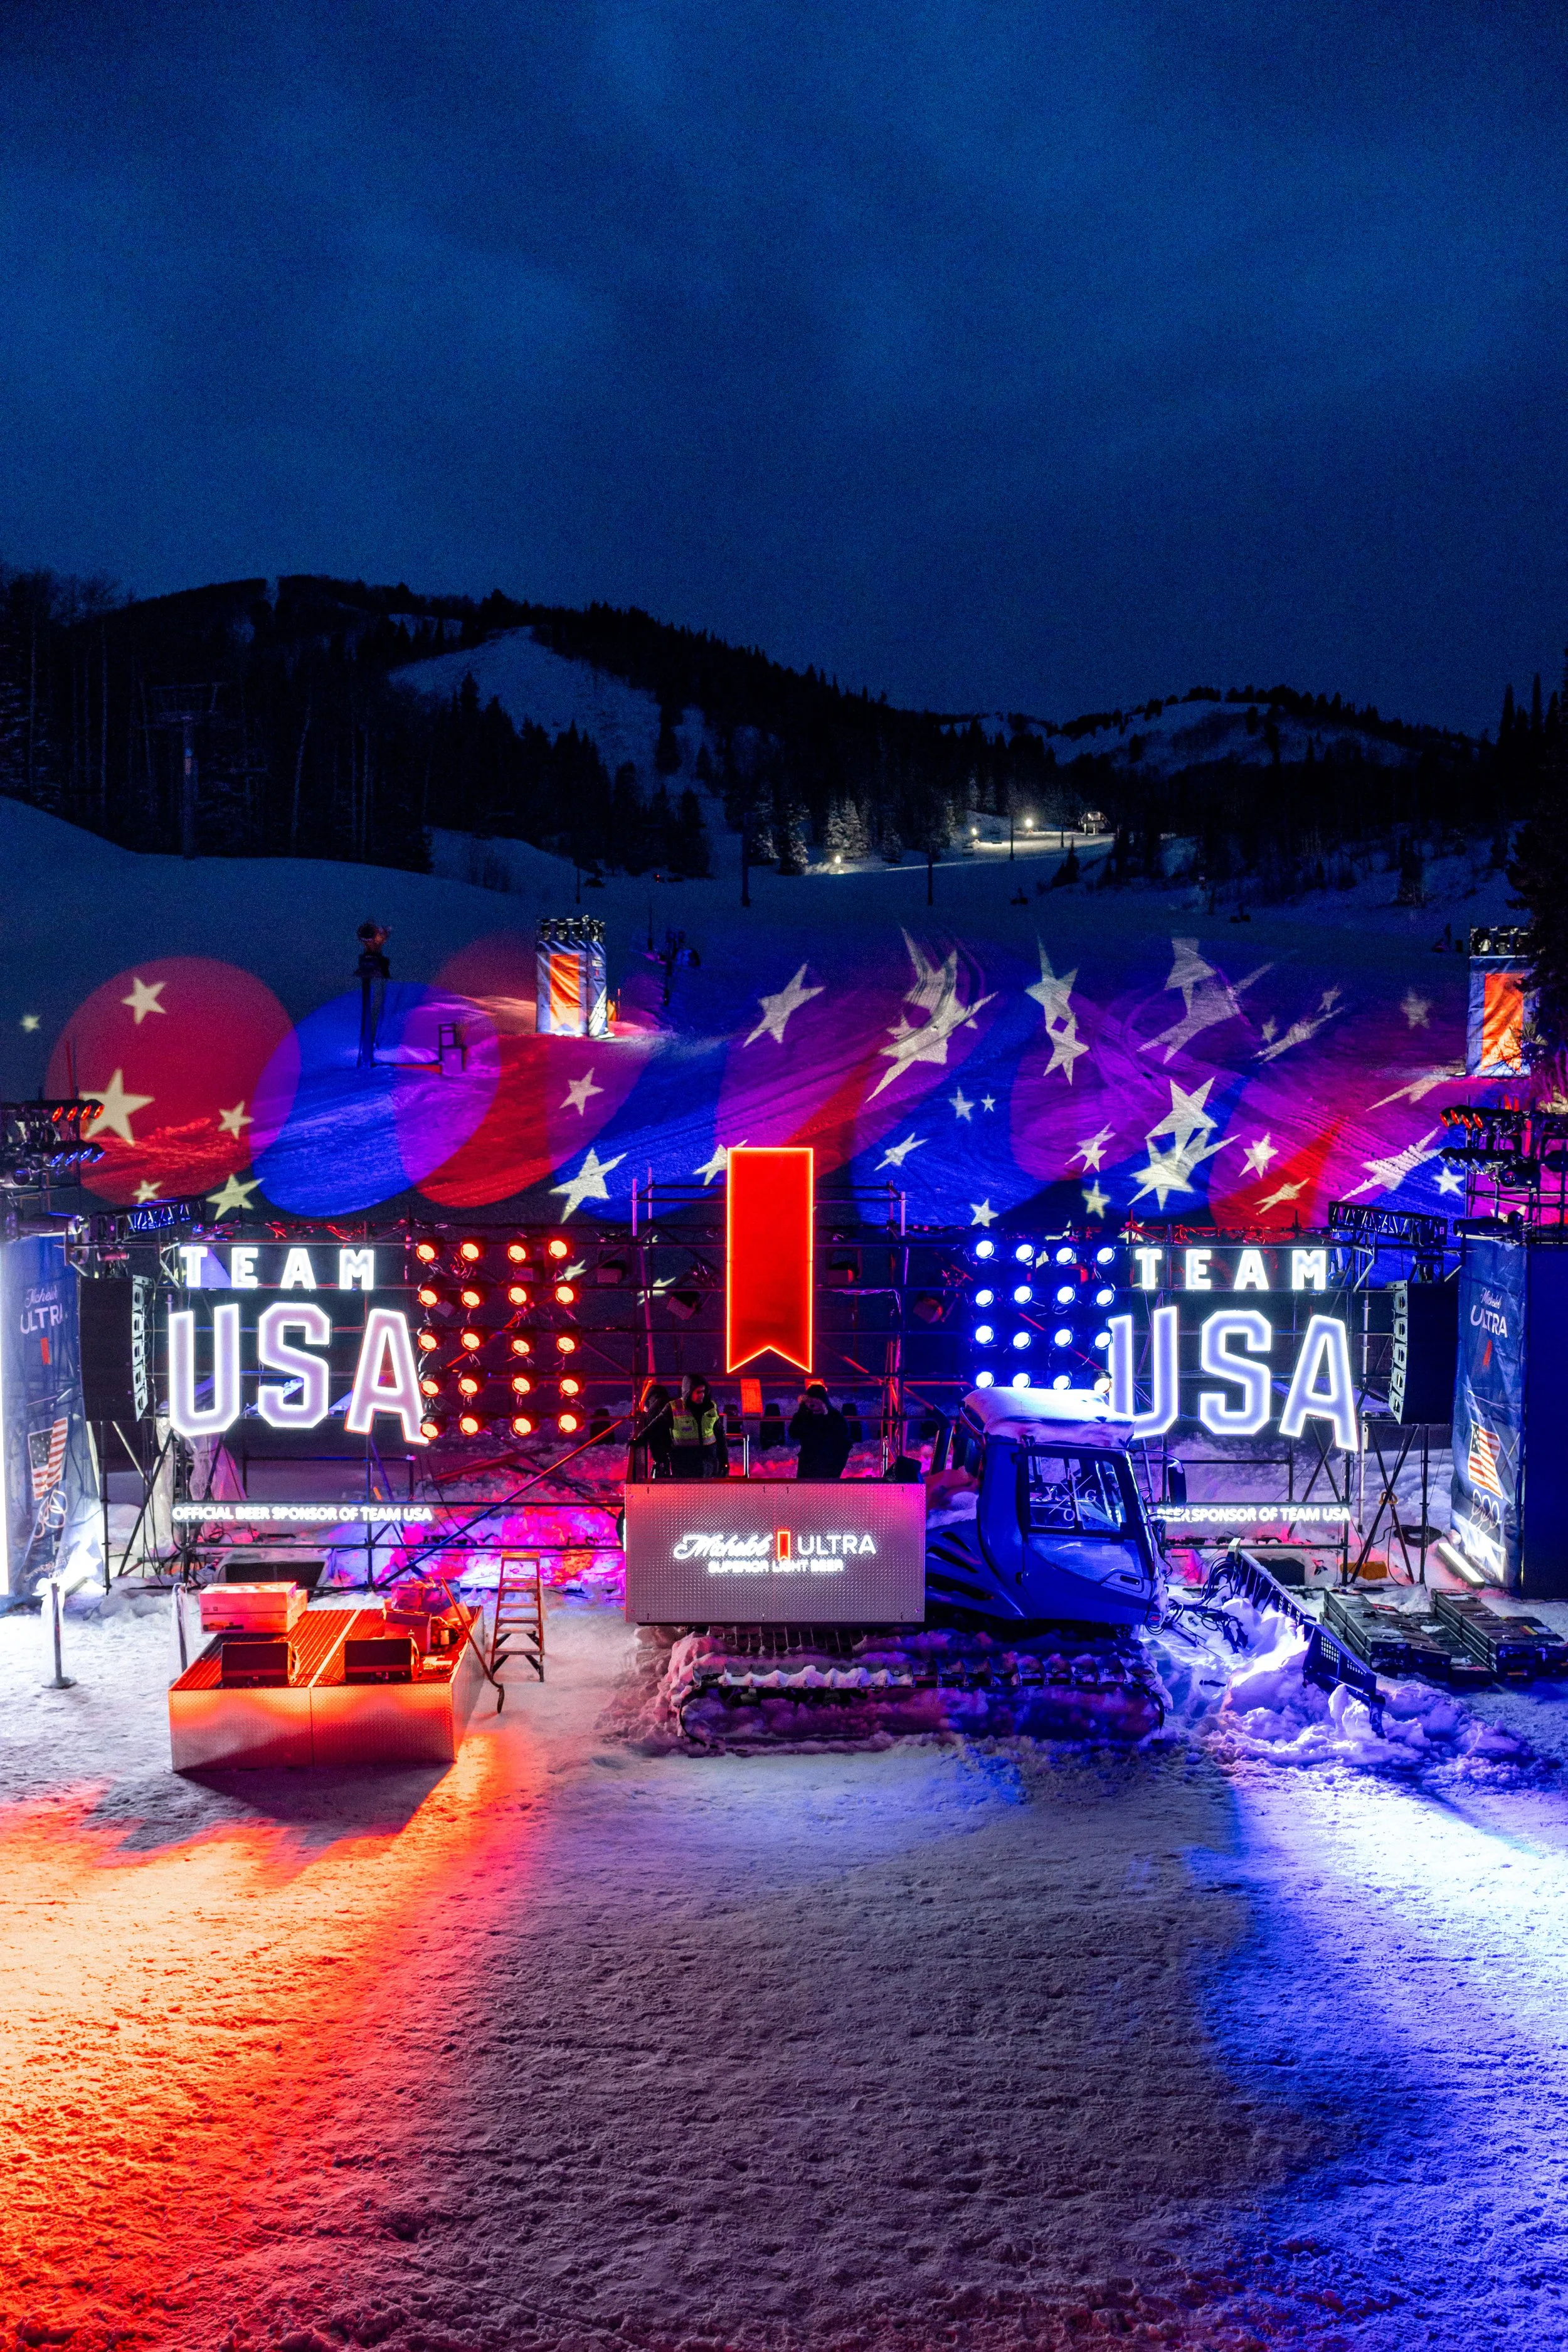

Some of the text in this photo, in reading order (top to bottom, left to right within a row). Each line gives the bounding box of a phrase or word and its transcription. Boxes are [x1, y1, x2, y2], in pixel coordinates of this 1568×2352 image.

[179, 1246, 375, 1291] TEAM
[1135, 1248, 1327, 1291] TEAM
[1470, 1305, 1508, 1338] ULTRA
[169, 1302, 431, 1446] USA
[1108, 1305, 1359, 1451] USA
[172, 1507, 433, 1522] OFFICIAL BEER SPONSOR OF TEAM USA
[1192, 1507, 1257, 1522] SPONSOR
[1258, 1507, 1278, 1522] OF
[1279, 1507, 1320, 1522] TEAM
[1322, 1507, 1351, 1522] USA
[673, 1534, 877, 1560] Michelob ULTRA
[772, 1560, 809, 1573] LIGHT
[810, 1559, 844, 1572] BEER
